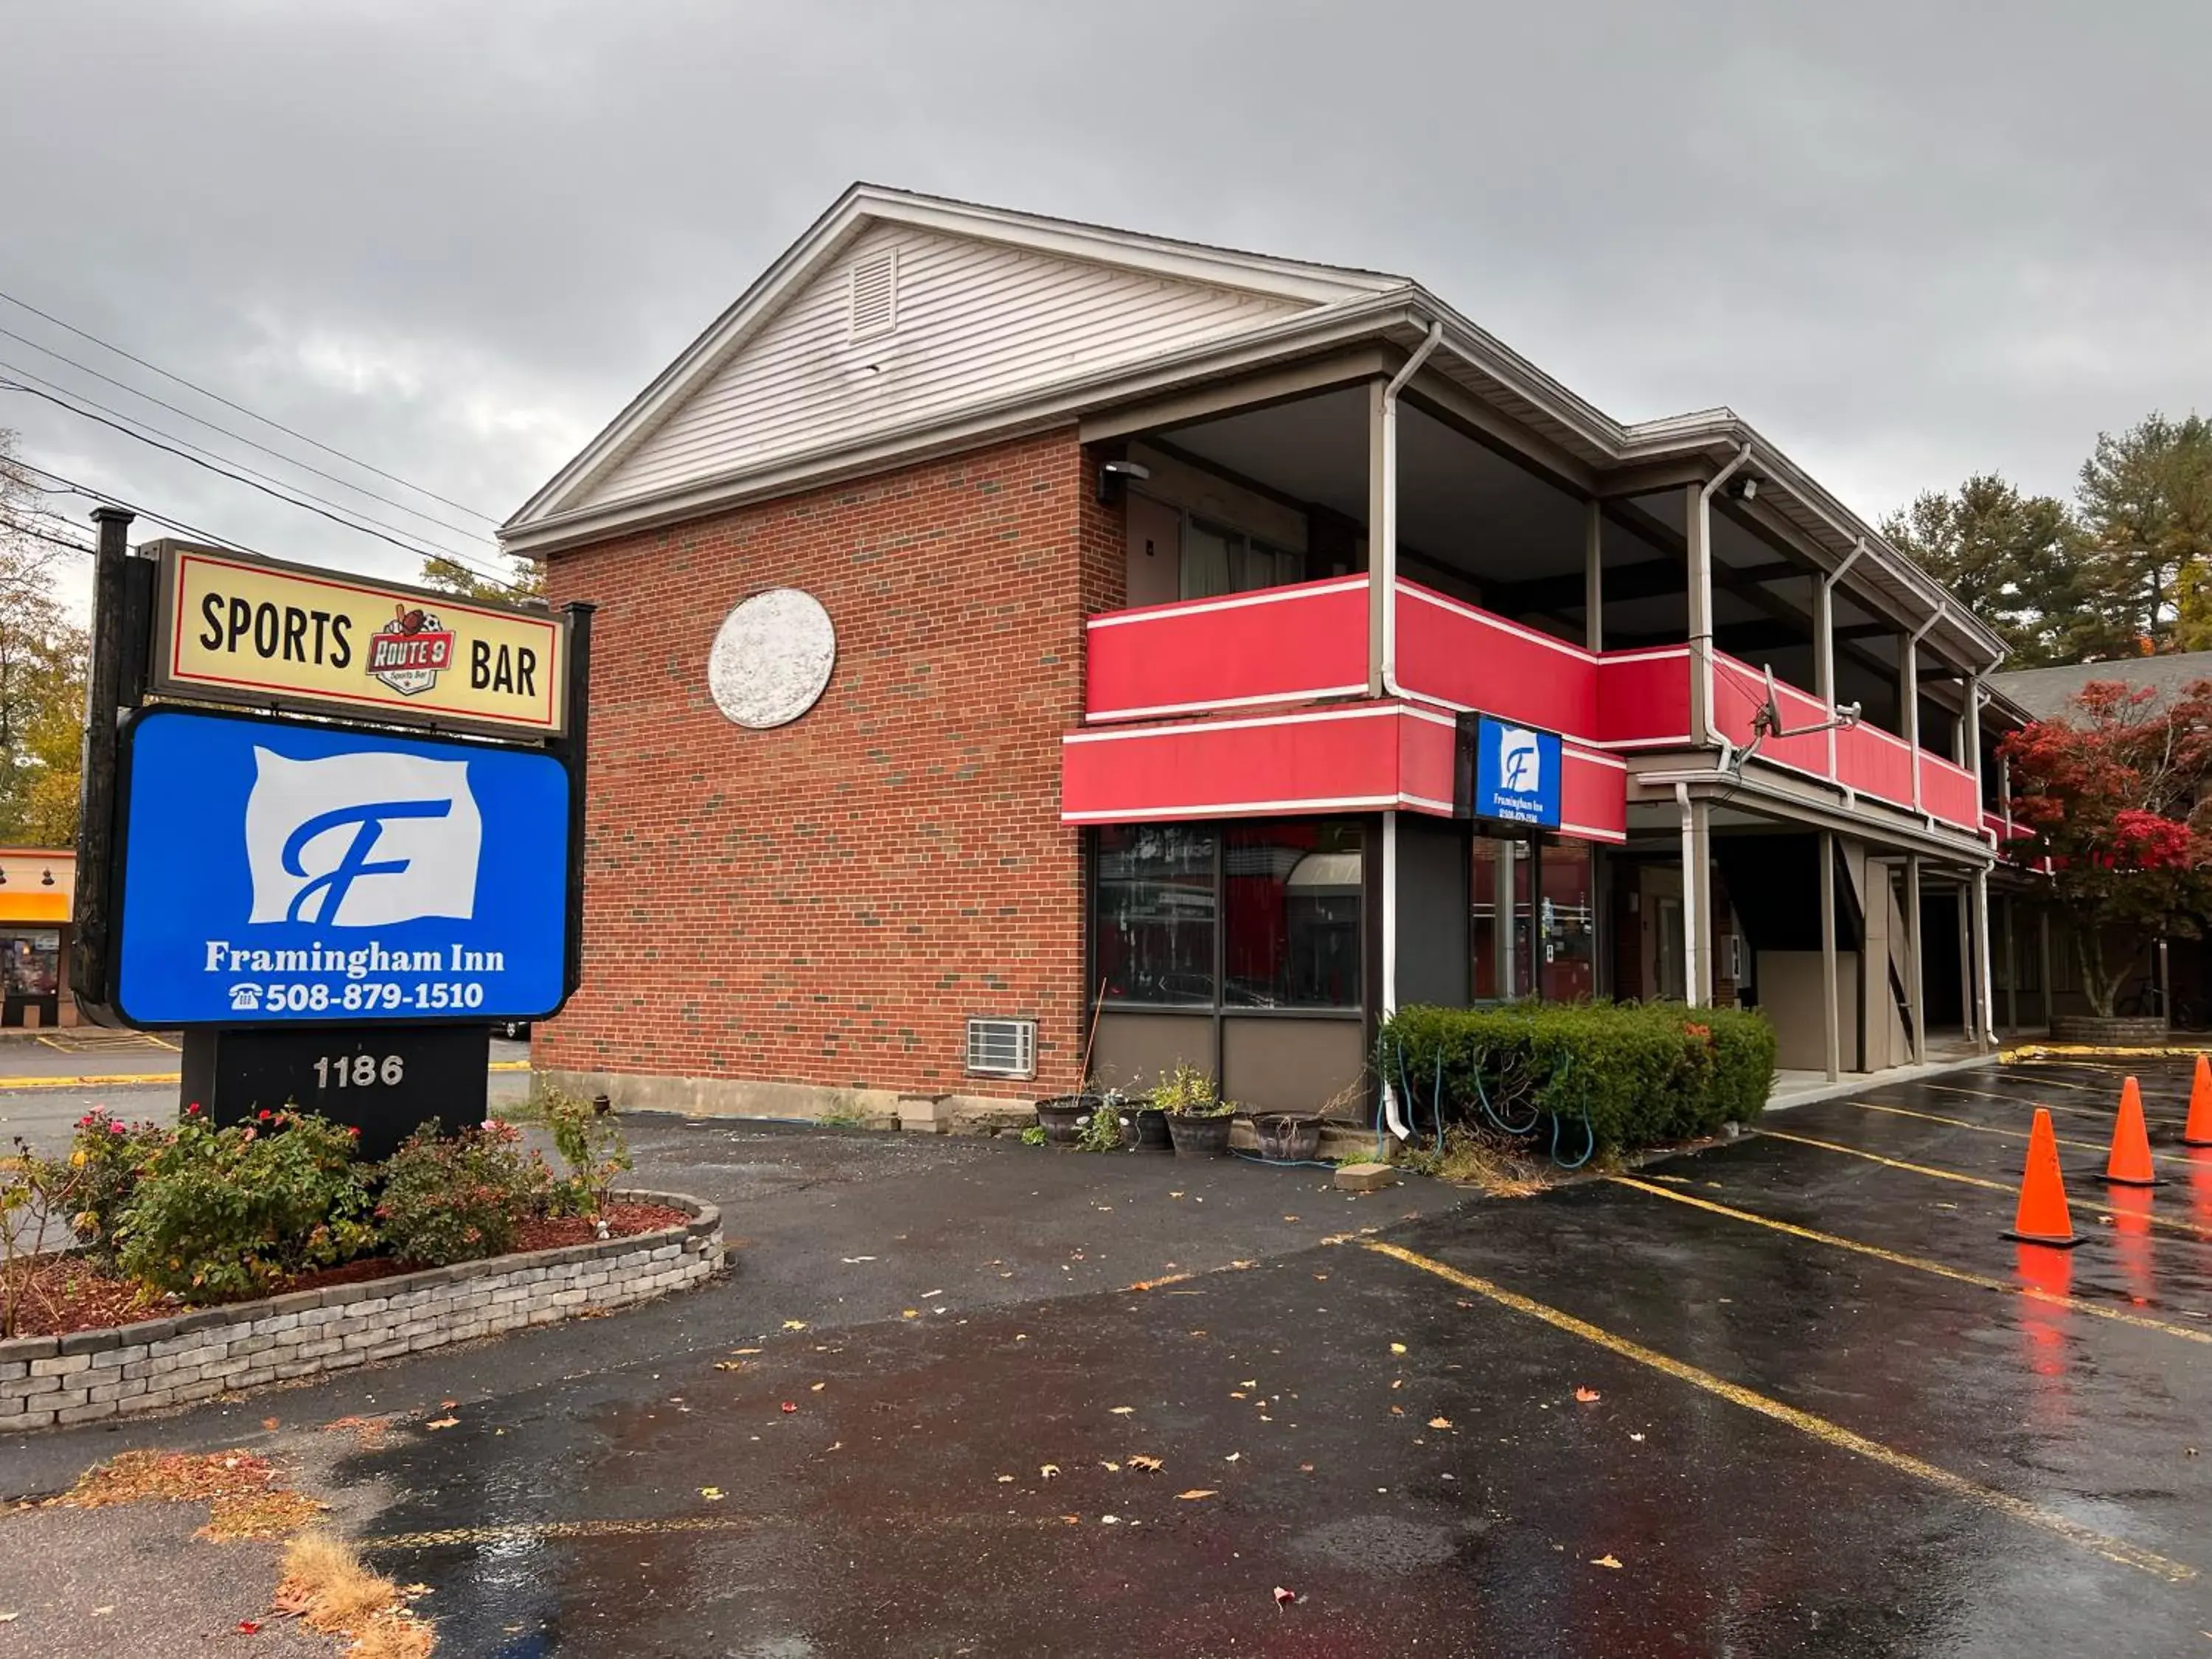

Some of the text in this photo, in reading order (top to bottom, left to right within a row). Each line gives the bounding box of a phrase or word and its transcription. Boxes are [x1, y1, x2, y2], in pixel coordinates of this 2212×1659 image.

[200, 592, 536, 697] SPORTS BAR
[375, 640, 446, 667] ROUTE 9
[282, 799, 452, 925] F
[206, 942, 504, 979] Framingham Inn
[266, 983, 483, 1012] 508-879-1510
[313, 1055, 404, 1089] 1186
